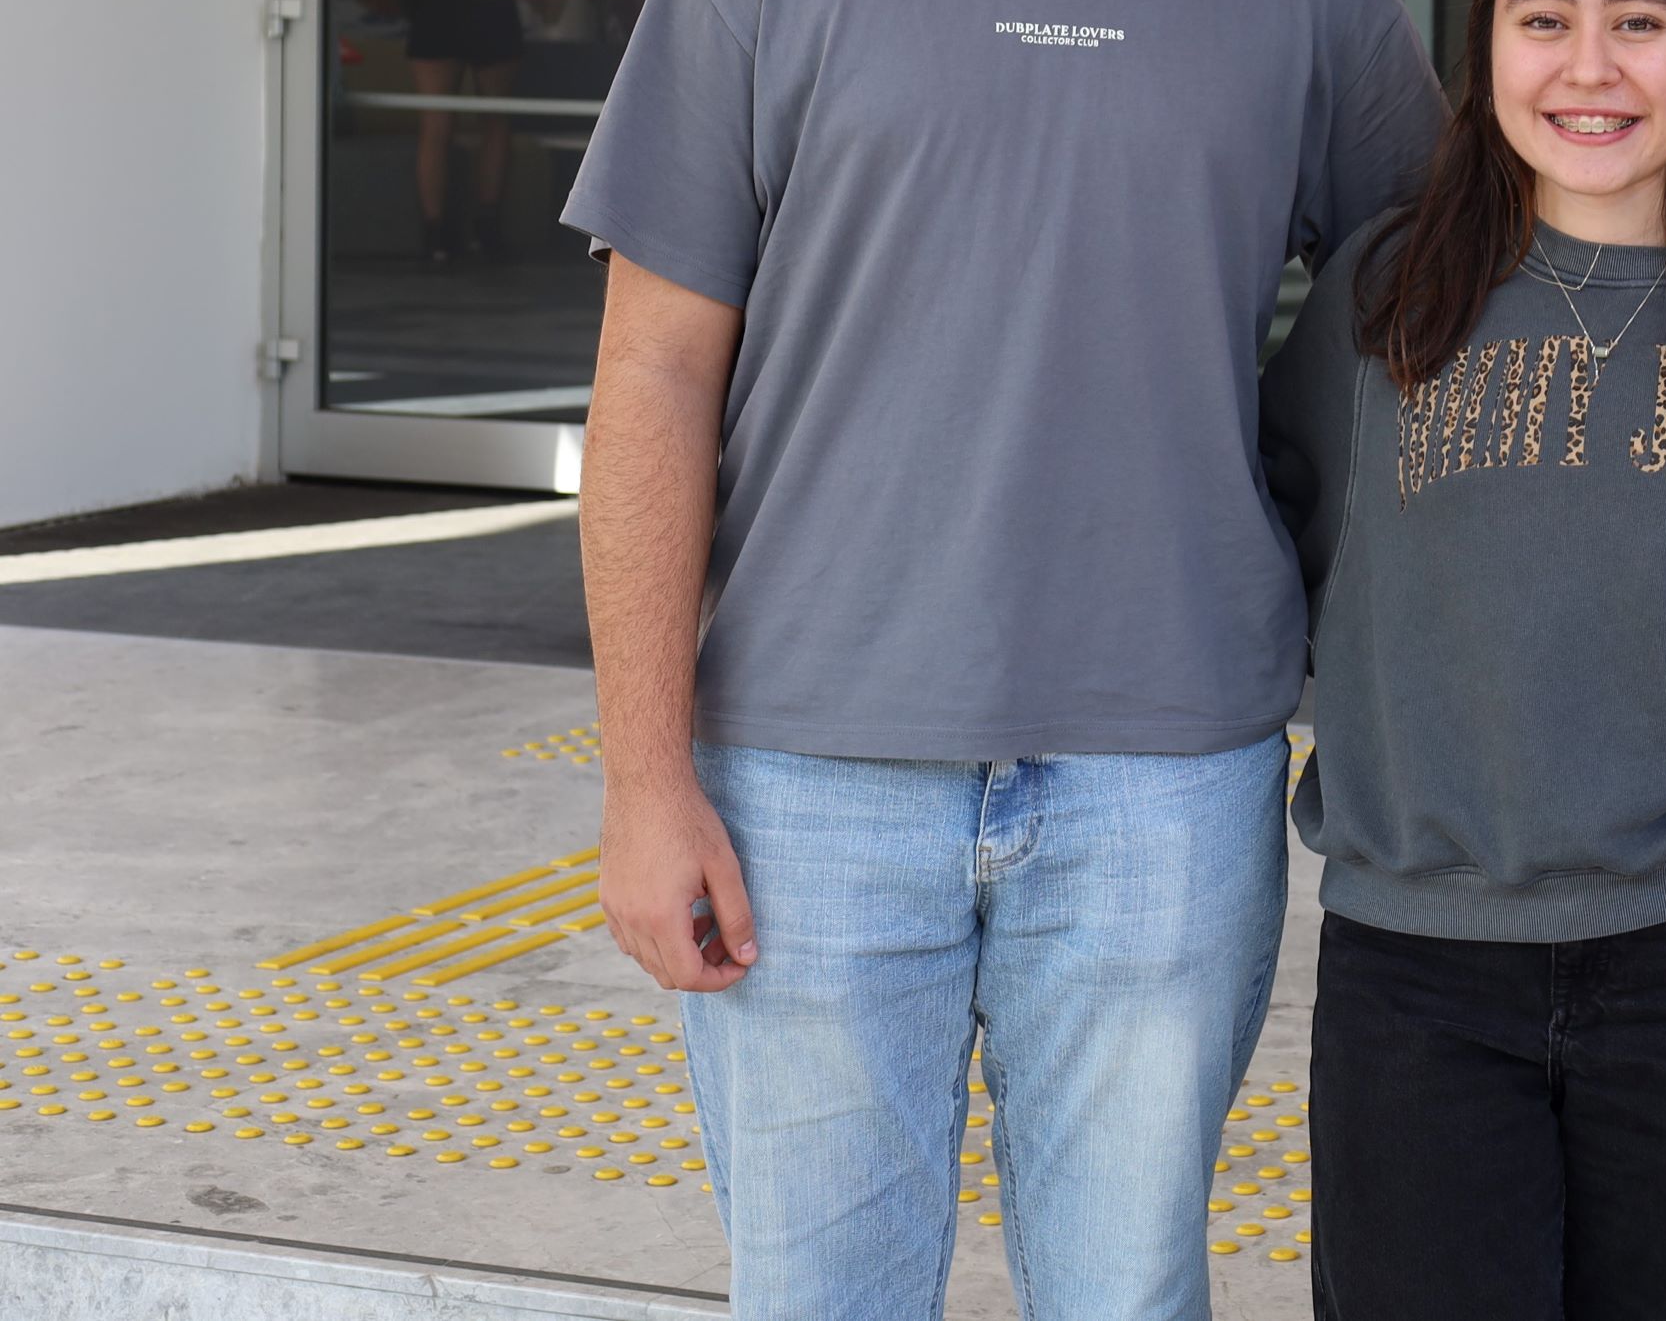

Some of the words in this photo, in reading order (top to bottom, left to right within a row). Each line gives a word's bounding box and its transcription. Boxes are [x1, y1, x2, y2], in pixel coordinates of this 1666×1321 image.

[995, 22, 1069, 37] DUBPLATE
[1072, 25, 1125, 41] LOVERS
[1021, 35, 1075, 46] COLLECTORS
[1077, 38, 1099, 47] CLUB
